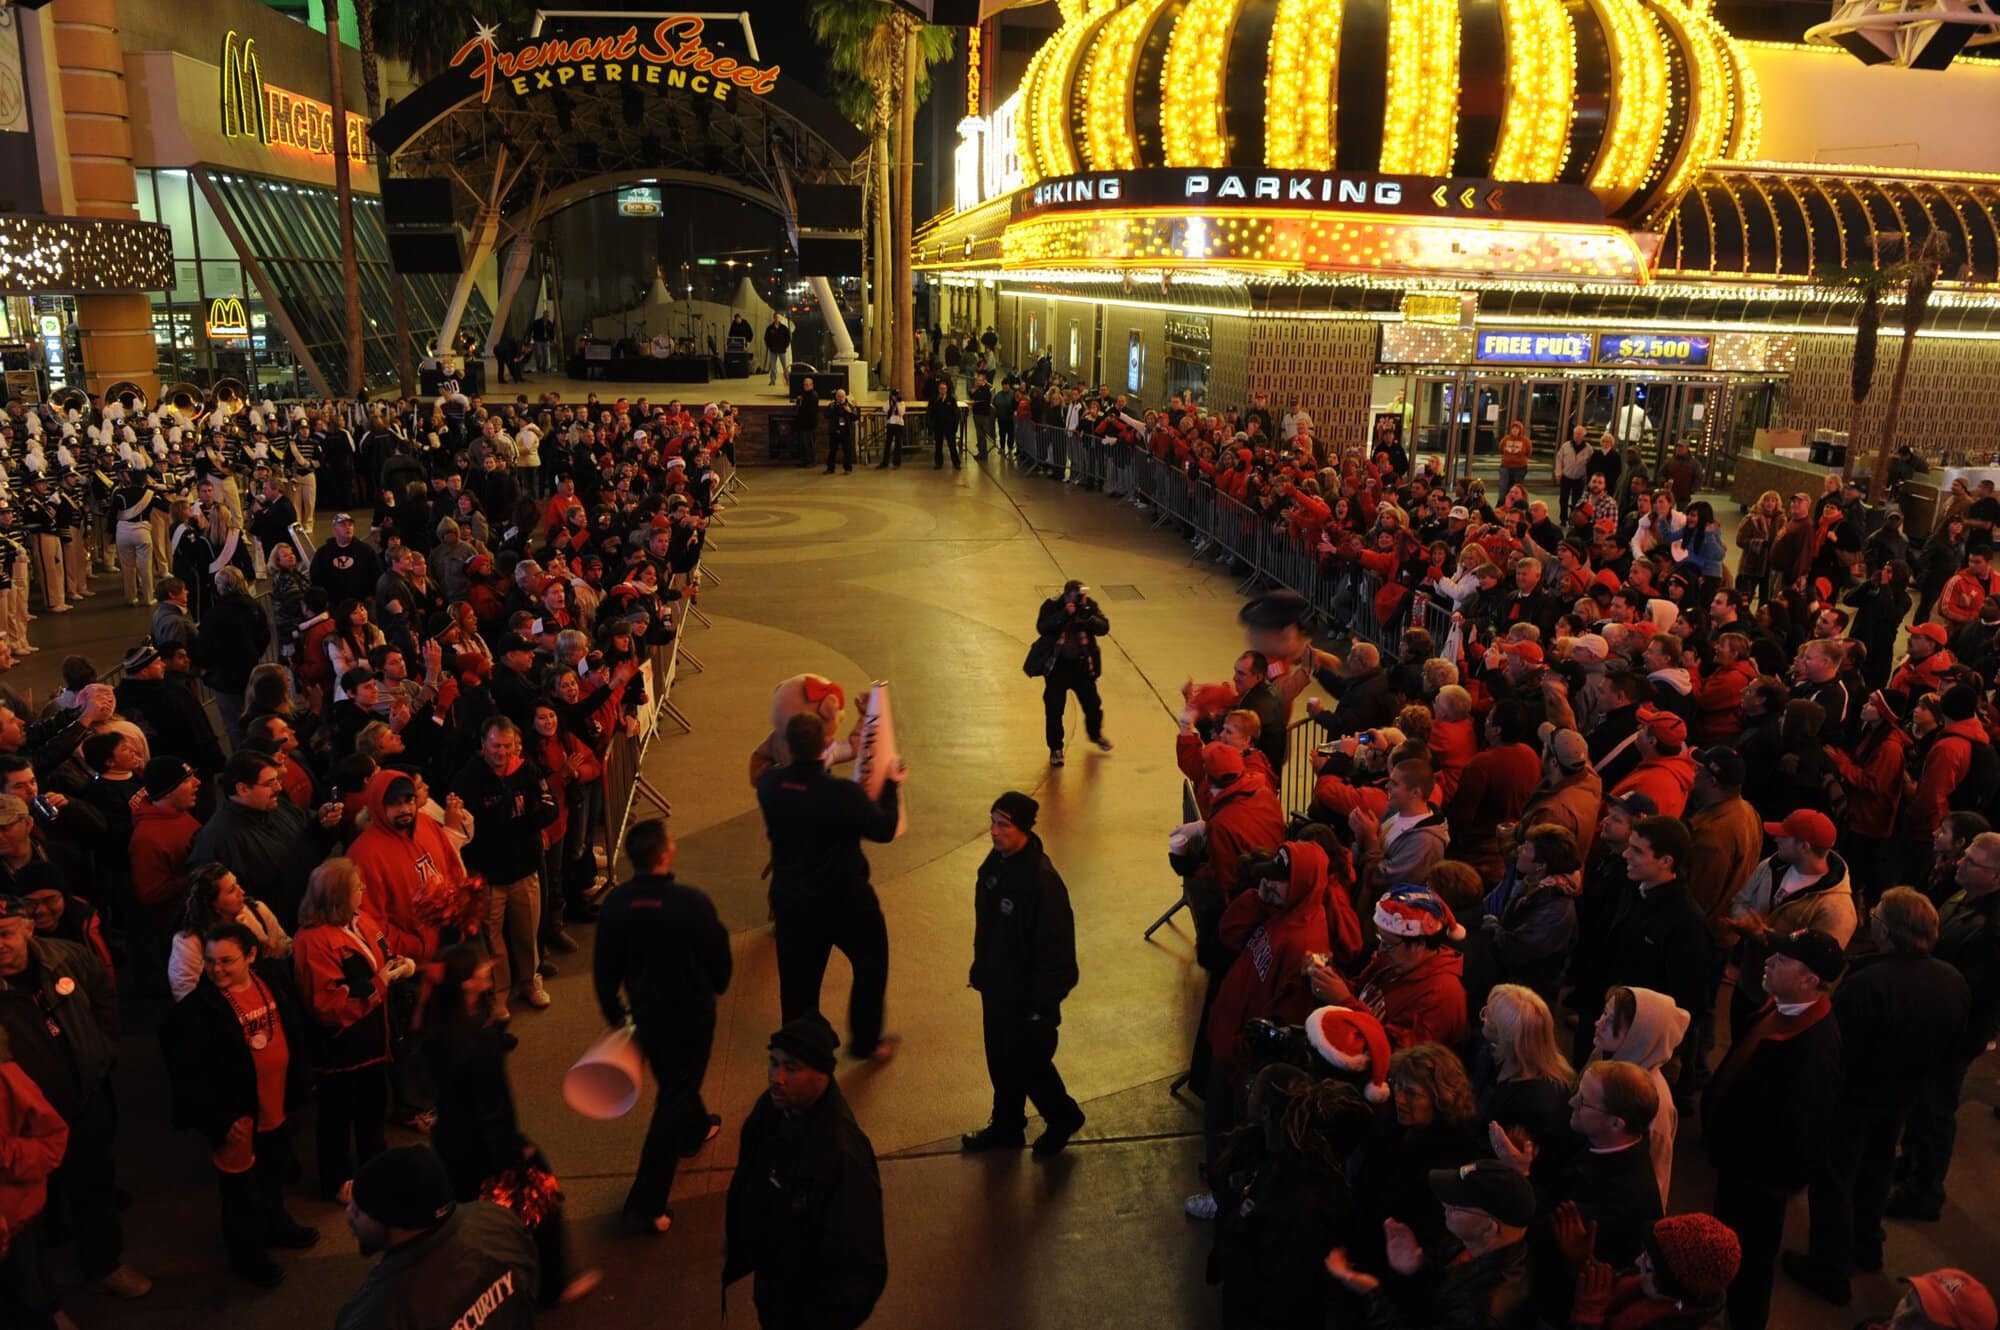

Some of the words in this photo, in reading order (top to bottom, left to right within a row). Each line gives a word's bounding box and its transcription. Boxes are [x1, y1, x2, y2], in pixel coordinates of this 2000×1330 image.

[450, 26, 638, 104] Fremont
[638, 15, 780, 95] Street
[511, 62, 733, 101] EXPERIENCE
[1185, 175, 1403, 205] PARKING
[1484, 335, 1531, 354] FREE
[1619, 341, 1690, 359] $2,500
